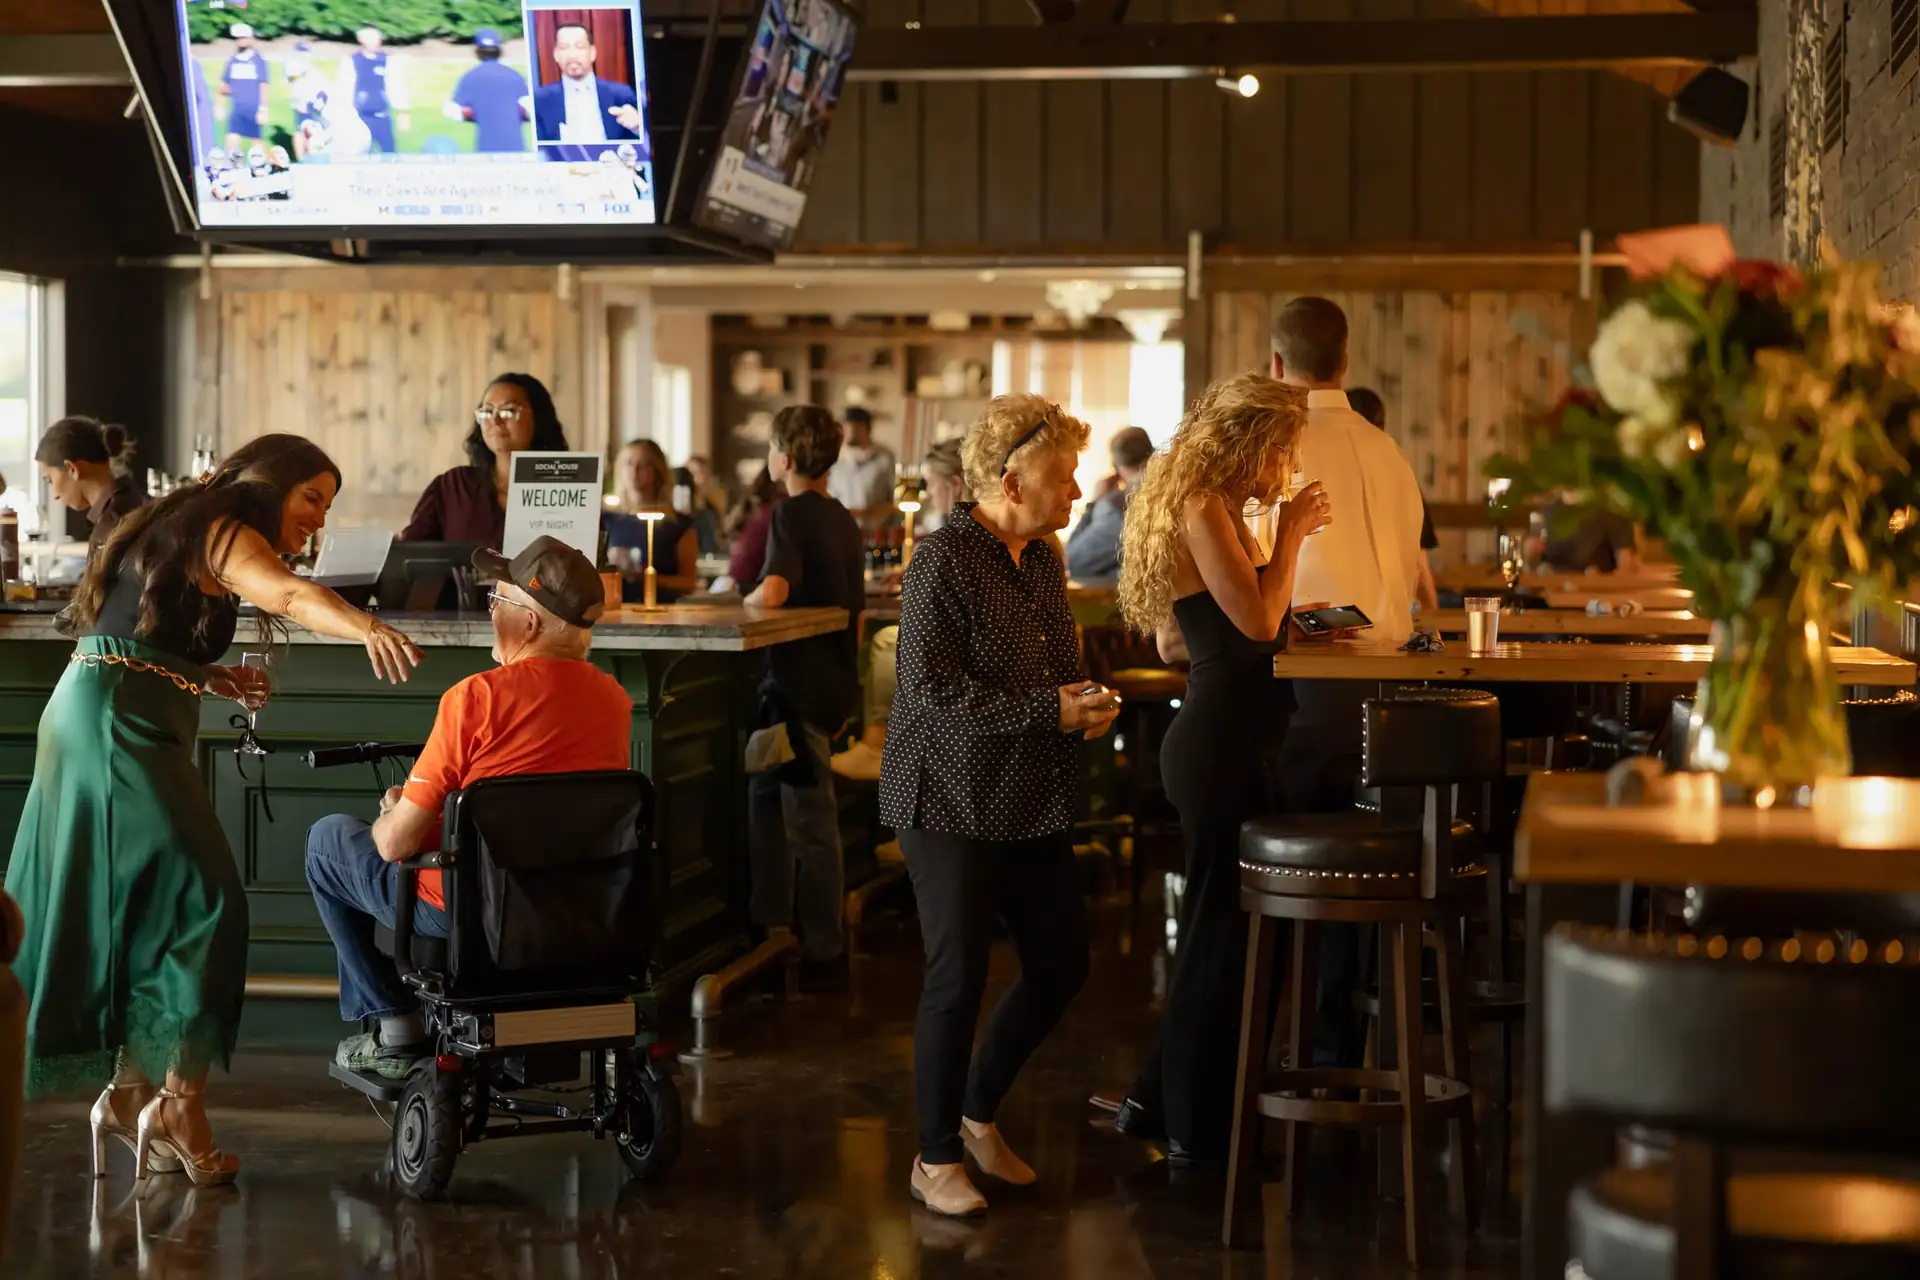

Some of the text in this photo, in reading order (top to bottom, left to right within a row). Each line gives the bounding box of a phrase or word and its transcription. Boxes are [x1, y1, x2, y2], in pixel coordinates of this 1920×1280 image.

[604, 203, 631, 214] FOX
[522, 489, 588, 507] WELCOME
[529, 520, 574, 529] VIP NIGHT
